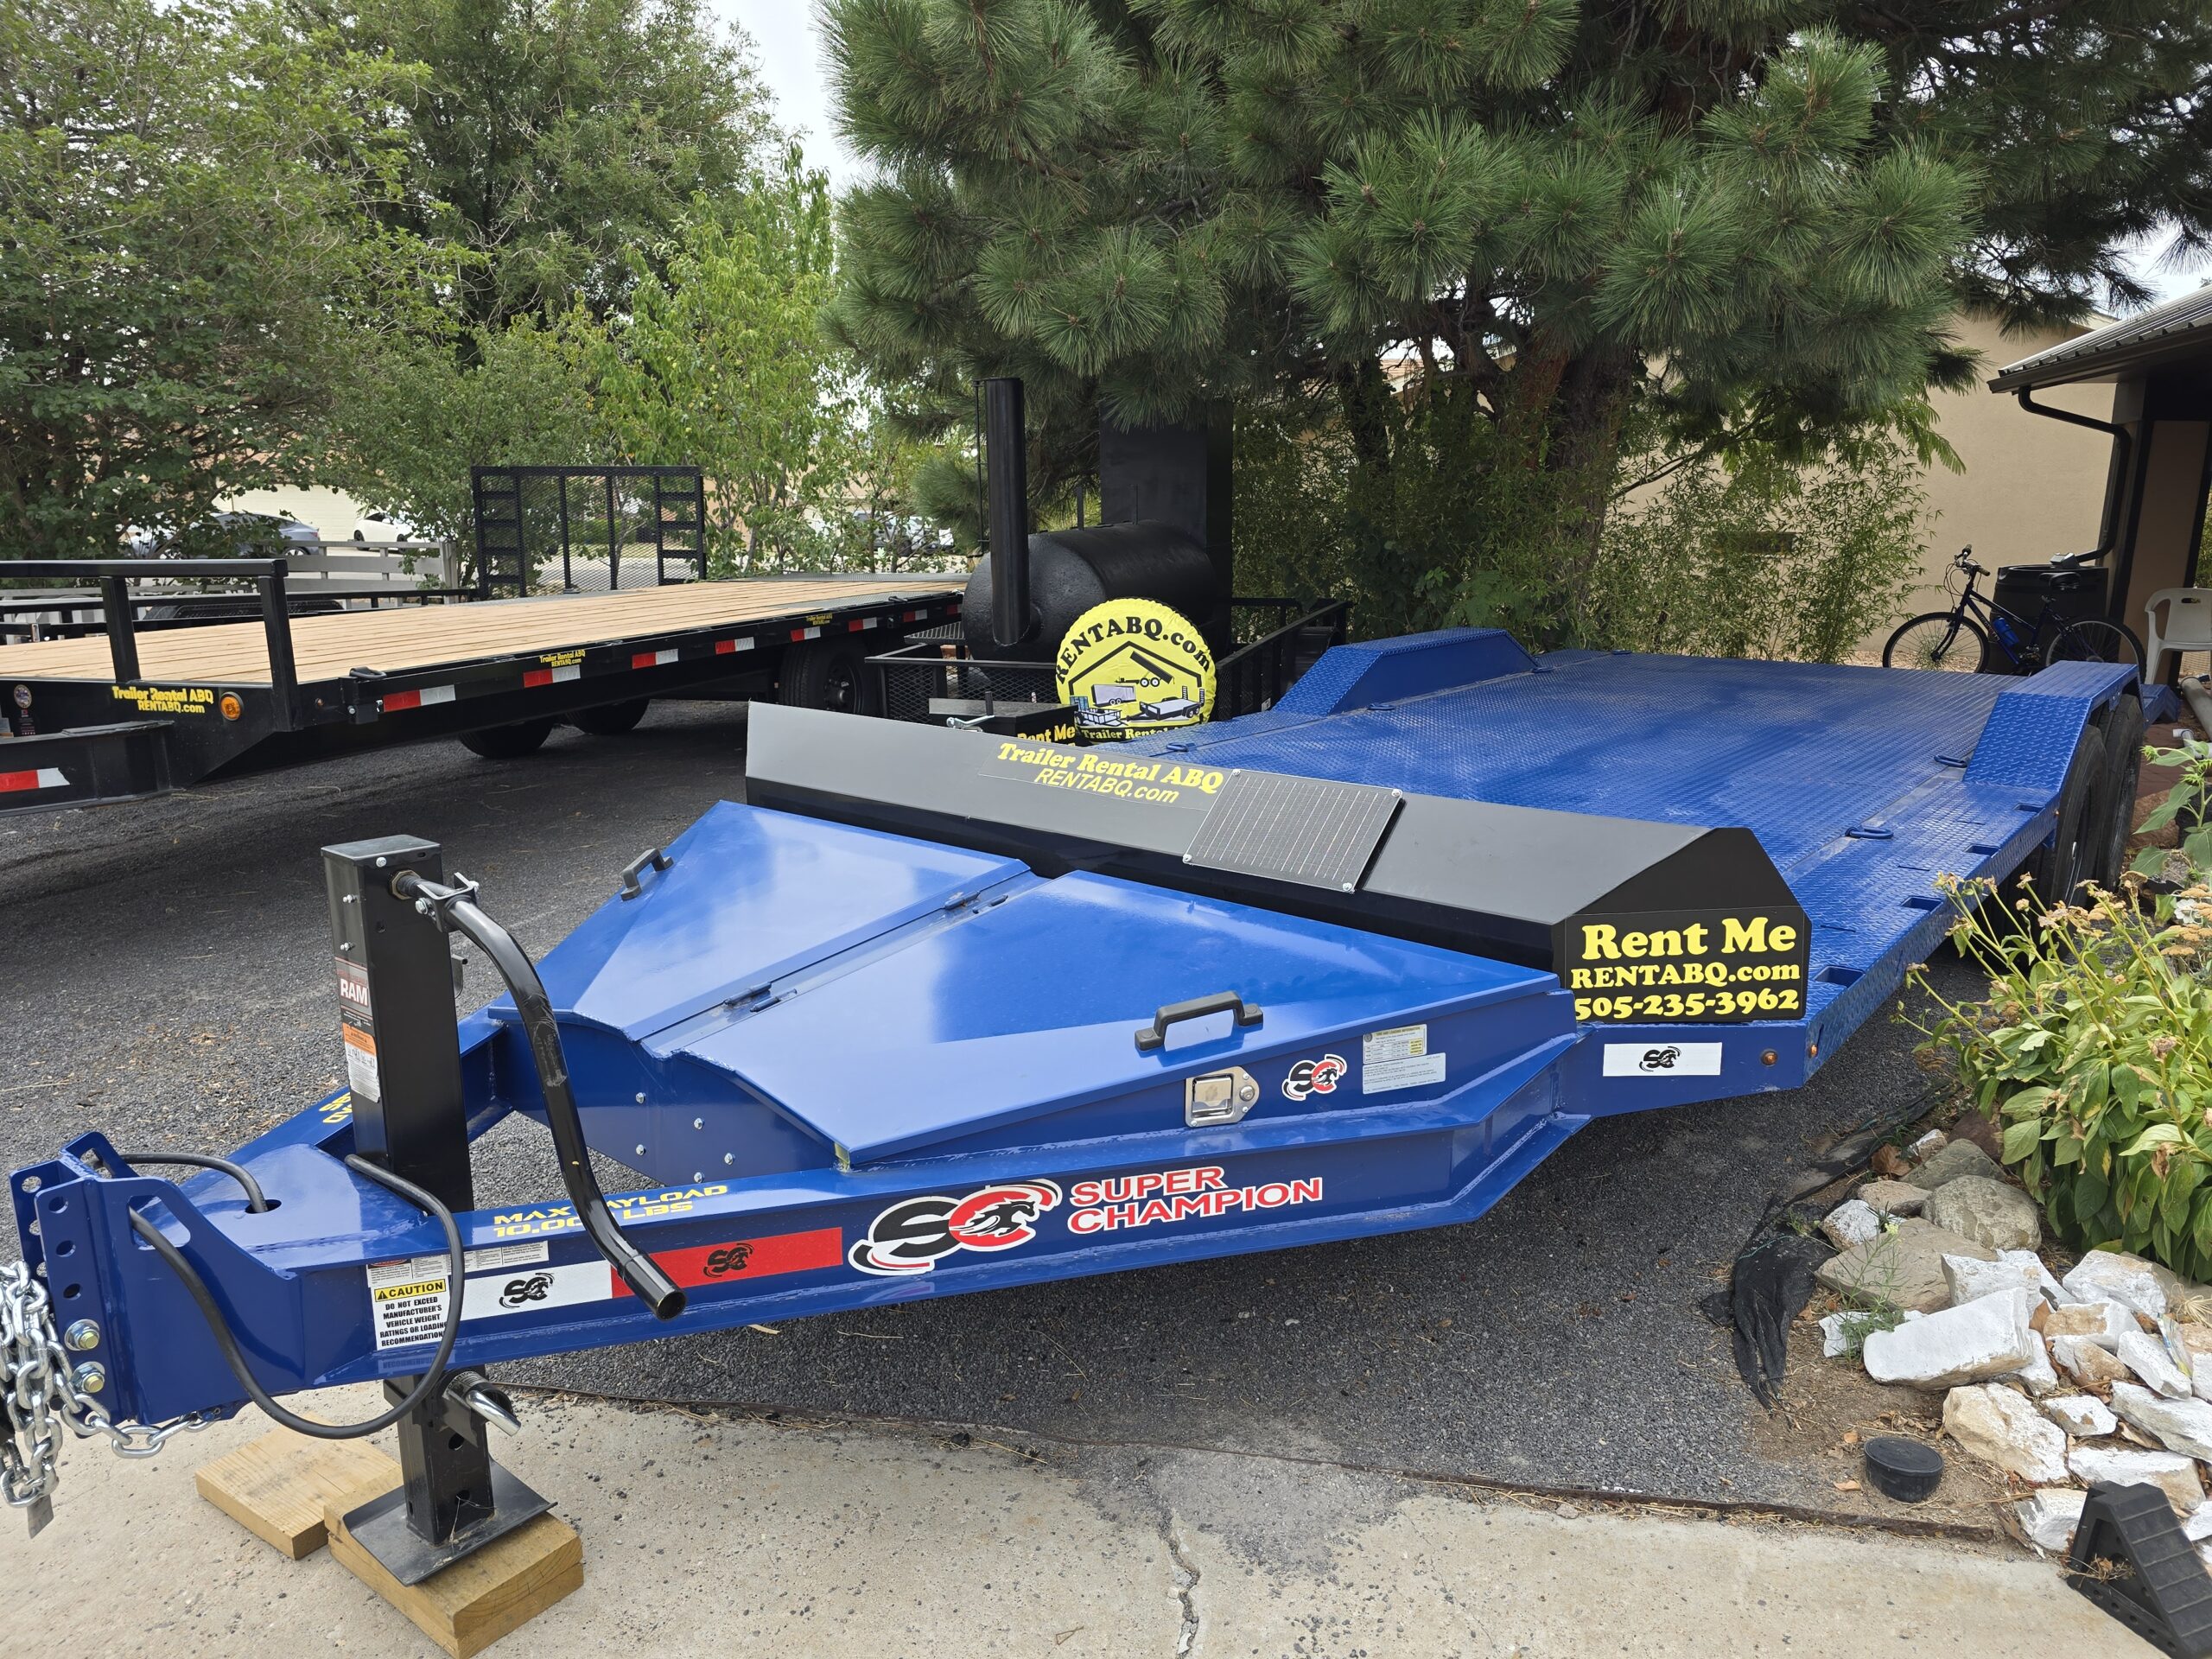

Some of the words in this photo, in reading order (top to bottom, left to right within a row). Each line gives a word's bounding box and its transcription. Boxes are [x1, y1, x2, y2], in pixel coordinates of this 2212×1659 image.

[539, 654, 556, 664] Trailer
[557, 652, 574, 661] Rental
[575, 649, 586, 658] ABQ
[1055, 616, 1211, 684] RENTABQ.com
[112, 686, 149, 701] Trailer
[149, 687, 188, 702] Rental
[189, 689, 213, 704] ABQ
[137, 700, 206, 714] RENTABQ.com
[1054, 723, 1076, 741] Me
[1081, 729, 1122, 740] Trailer
[997, 742, 1076, 769] Trailer
[1077, 753, 1161, 782] Rental
[1160, 766, 1224, 794] ABQ
[1034, 767, 1179, 804] RENTABQ.com
[1581, 923, 1708, 960] Rent
[1721, 917, 1796, 954] Me
[1571, 962, 1801, 989] RENTABQ.com
[340, 978, 369, 1007] RAM
[1574, 988, 1800, 1020] 505-235-3962
[1070, 1166, 1225, 1206] SUPER
[493, 1205, 572, 1224] MAX
[607, 1185, 728, 1209] AYLOAD
[623, 1200, 693, 1220] LBS
[1068, 1176, 1324, 1233] CHAMPION
[389, 1282, 443, 1297] CAUTION
[414, 1296, 438, 1306] EXCEED
[383, 1305, 442, 1319] MANUFACTURER'S
[386, 1318, 413, 1328] VEHICLE
[414, 1313, 441, 1325] WEIGHT
[380, 1327, 409, 1338] RATINGS
[381, 1331, 445, 1347] RECOMMENDATION
